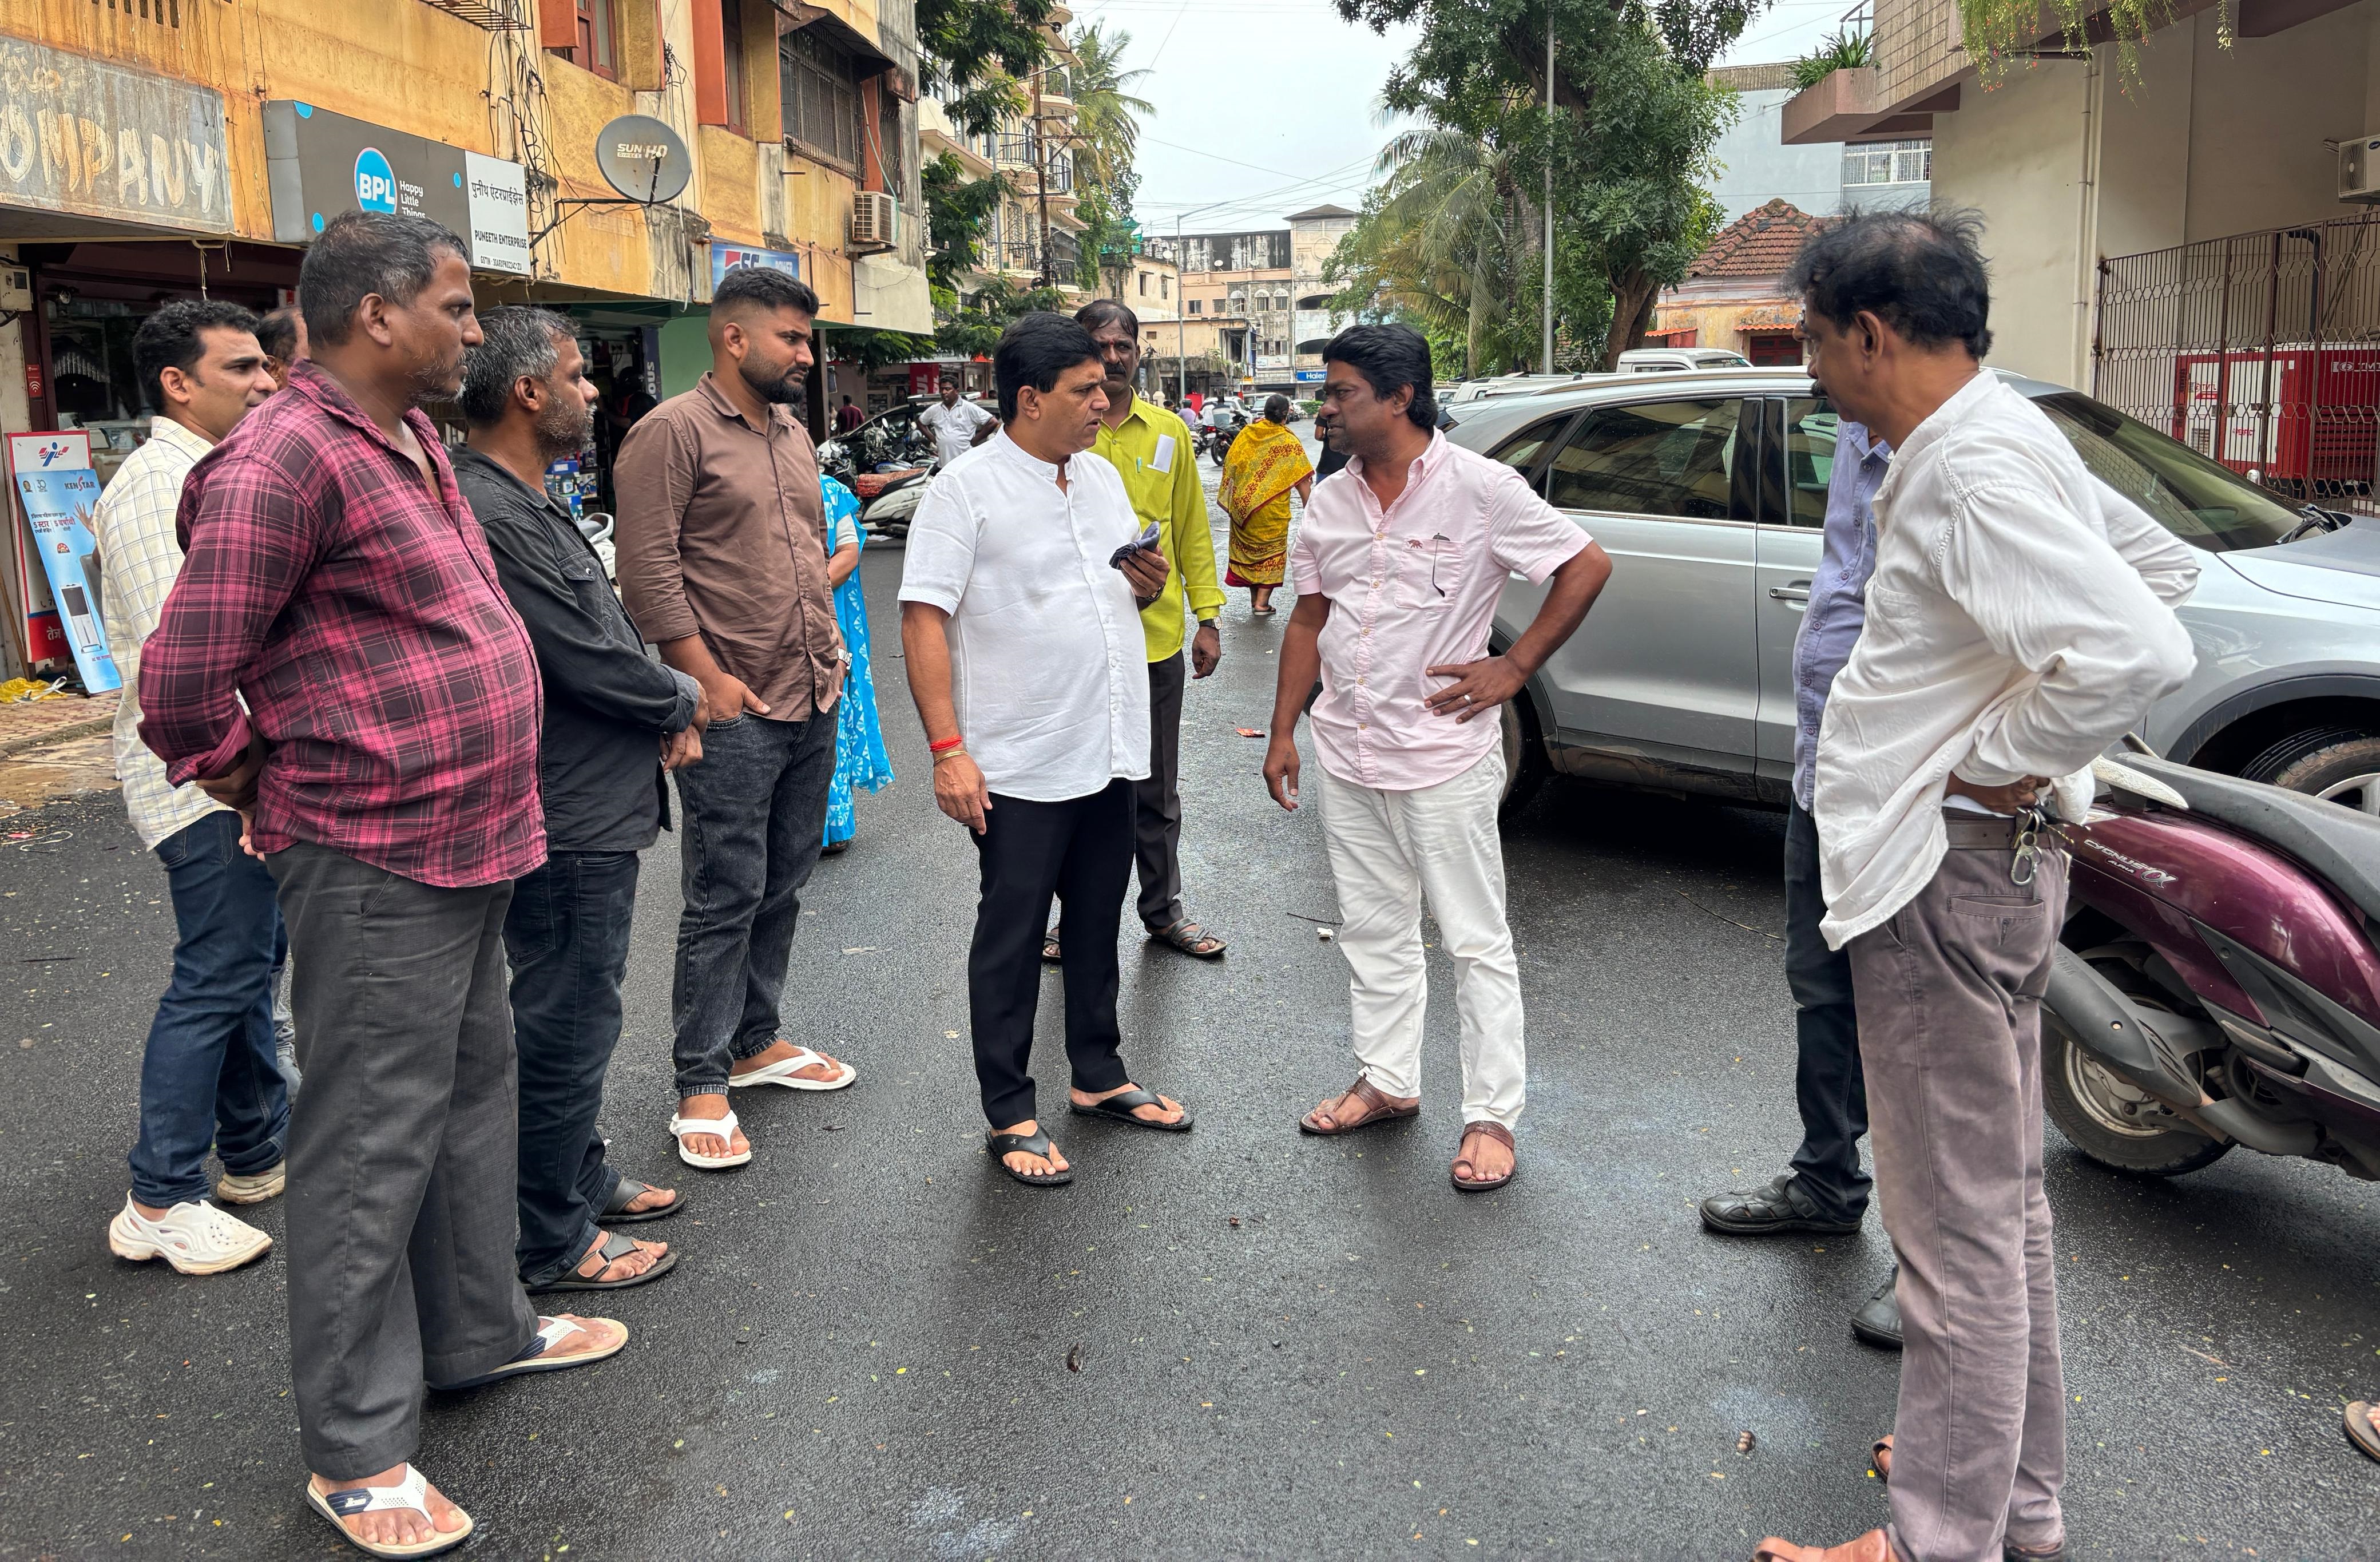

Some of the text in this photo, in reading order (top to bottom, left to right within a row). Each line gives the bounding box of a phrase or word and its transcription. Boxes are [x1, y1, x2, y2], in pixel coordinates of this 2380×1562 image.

[617, 144, 642, 153] SUN
[360, 173, 395, 205] BPL
[400, 180, 423, 197] Happy
[471, 180, 489, 198] पुनीथ
[401, 193, 419, 207] Little
[474, 229, 527, 249] PUNEETH ENTERPRISE
[64, 475, 96, 491] KENSTAR
[2084, 839, 2148, 870] CYGNUS
[2107, 860, 2135, 873] ALPHA
